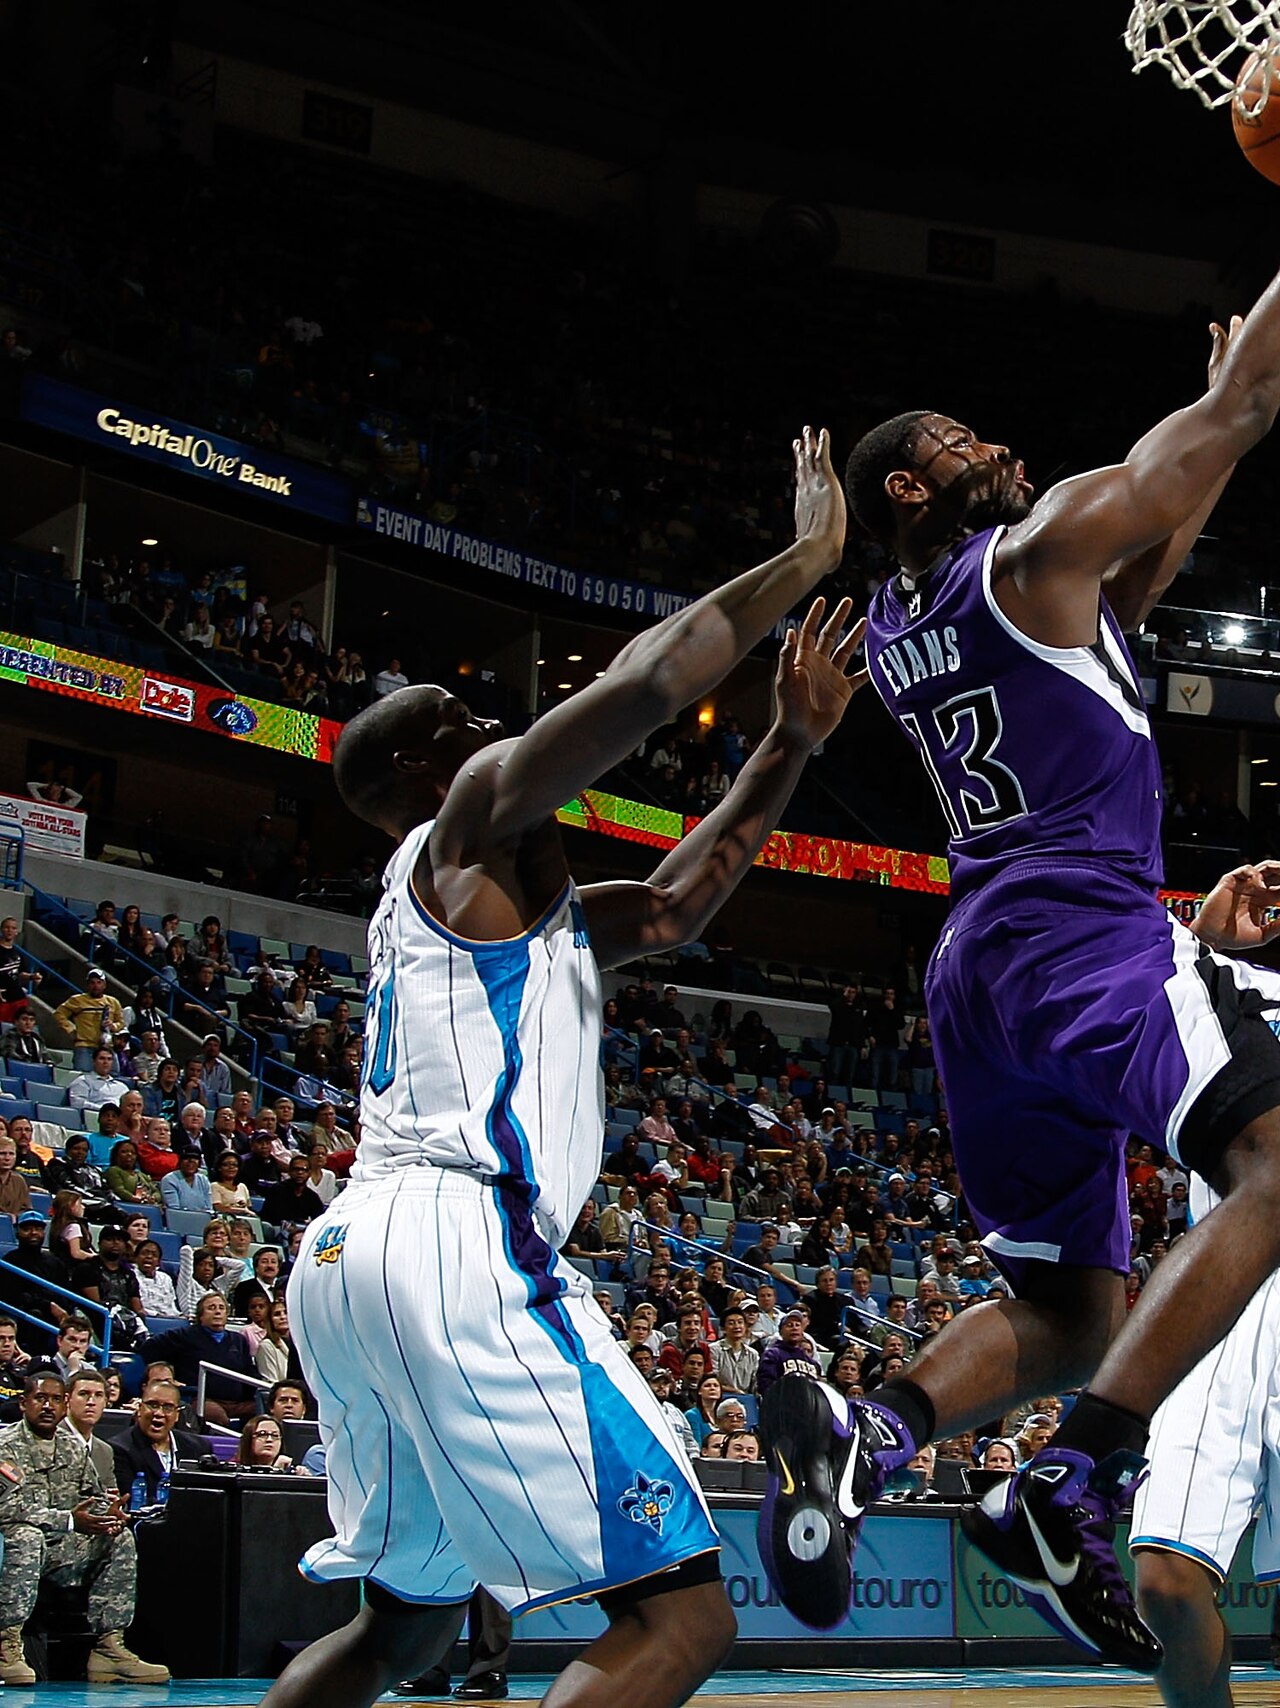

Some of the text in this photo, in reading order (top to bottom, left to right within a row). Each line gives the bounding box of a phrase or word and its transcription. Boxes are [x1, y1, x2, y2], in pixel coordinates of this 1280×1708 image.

[239, 464, 293, 495] Bank
[375, 506, 422, 544] EVENT
[423, 523, 451, 554] DAY
[452, 533, 523, 578] PROBLEMS
[524, 557, 558, 590] TEXT
[559, 568, 577, 596] TO
[877, 626, 960, 697] EVANS
[899, 686, 1029, 839] 13
[852, 1570, 941, 1609] touro
